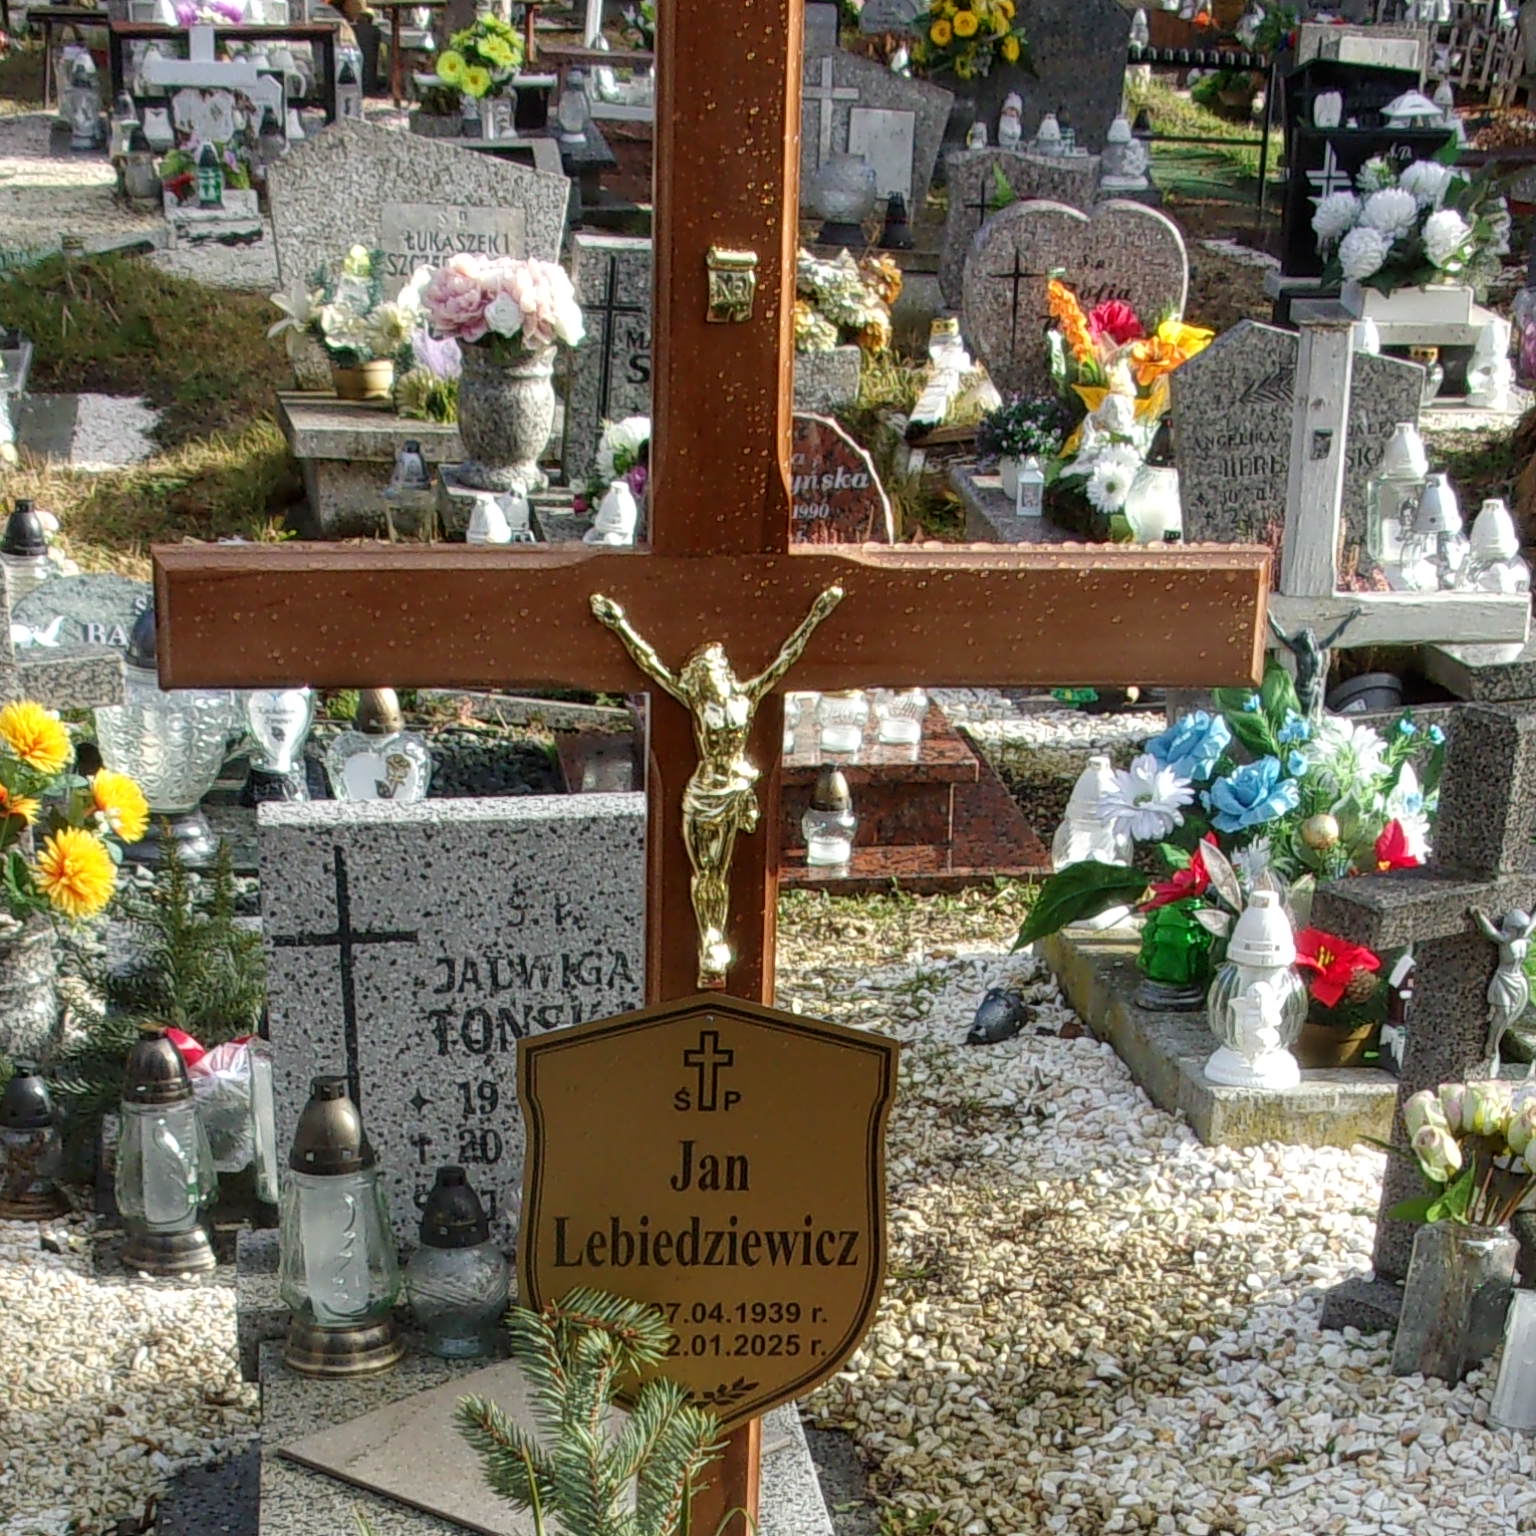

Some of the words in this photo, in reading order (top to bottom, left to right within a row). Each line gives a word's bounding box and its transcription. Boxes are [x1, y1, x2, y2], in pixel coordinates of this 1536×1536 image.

[405, 231, 499, 253] ŁUKASZEK
[724, 1090, 742, 1112] P
[670, 1140, 750, 1192] Jan
[553, 1215, 860, 1268] Lebiedziewicz
[663, 1334, 801, 1357] 2.01.2025
